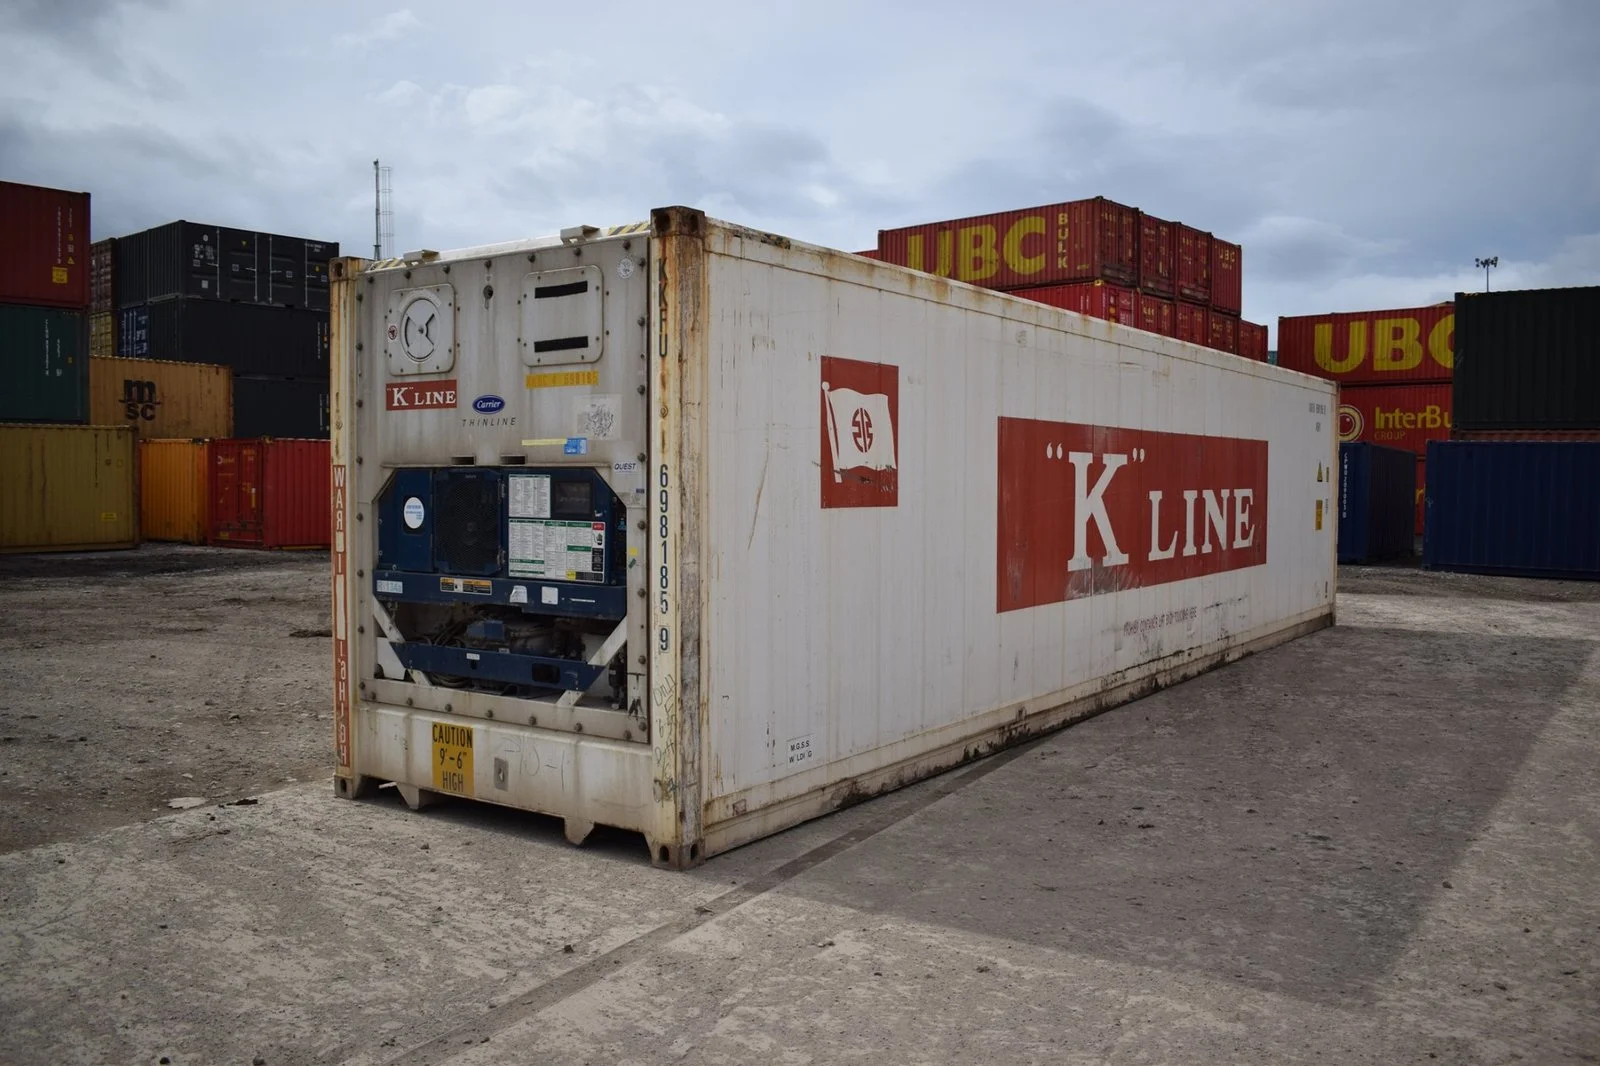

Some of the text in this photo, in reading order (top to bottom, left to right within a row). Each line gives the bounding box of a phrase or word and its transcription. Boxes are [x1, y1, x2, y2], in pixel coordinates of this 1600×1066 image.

[907, 216, 1046, 282] UBC
[1058, 213, 1068, 268] BULK
[659, 257, 668, 357] KKFU
[414, 390, 457, 406] LINE
[476, 399, 501, 409] Carrier
[462, 417, 517, 427] THINLINE
[1374, 431, 1406, 441] GROUP
[614, 462, 636, 471] QUEST
[1147, 488, 1255, 562] LINE
[659, 463, 669, 615] 698185
[432, 724, 473, 749] CAUTION
[442, 770, 464, 793] HIGH
